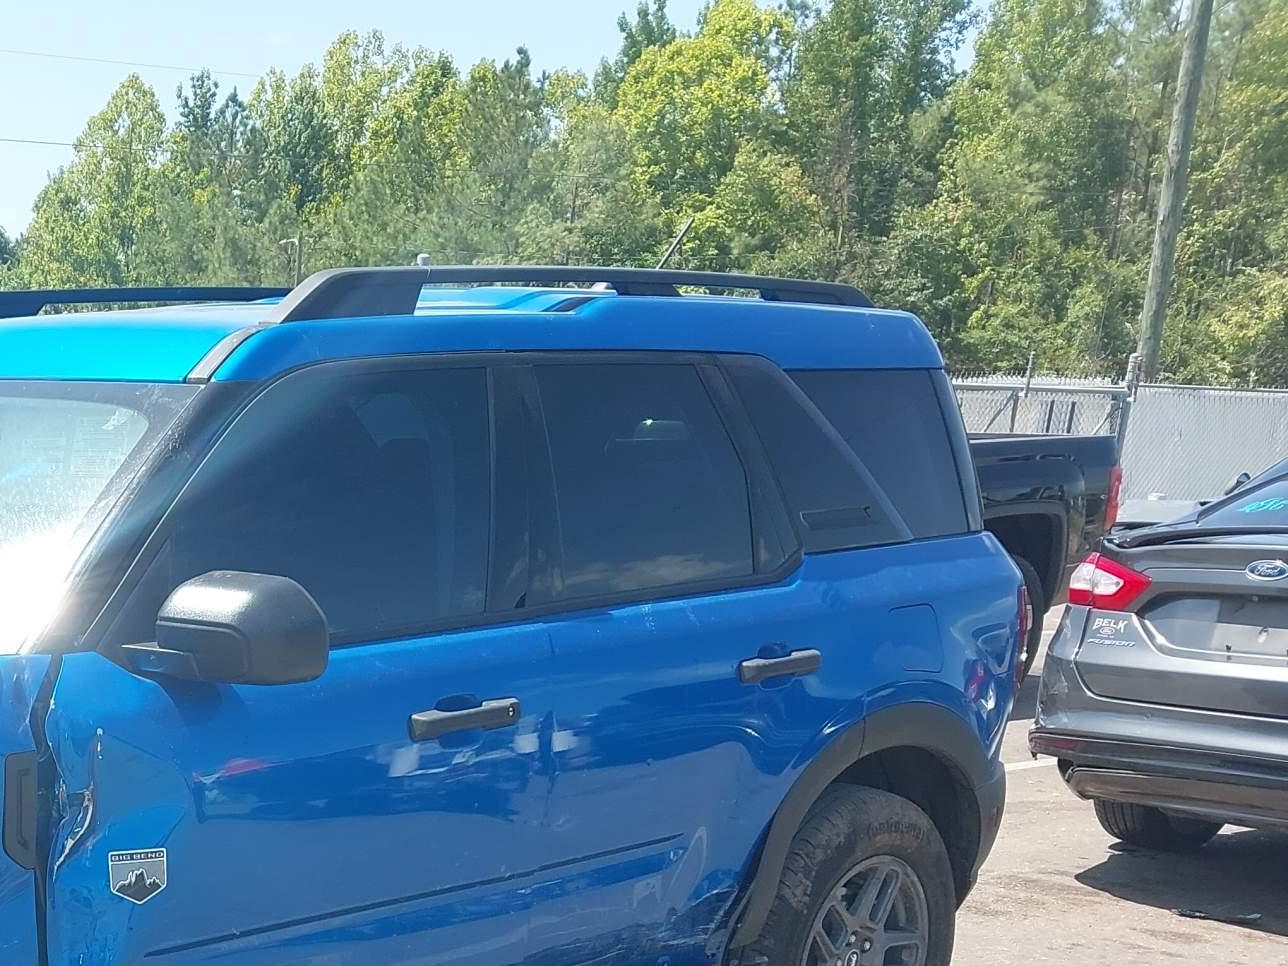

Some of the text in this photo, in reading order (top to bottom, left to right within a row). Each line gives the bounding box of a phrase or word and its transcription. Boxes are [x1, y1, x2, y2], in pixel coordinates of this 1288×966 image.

[1254, 562, 1282, 577] Ford
[1092, 617, 1129, 633] BELK
[133, 851, 163, 859] BEND
